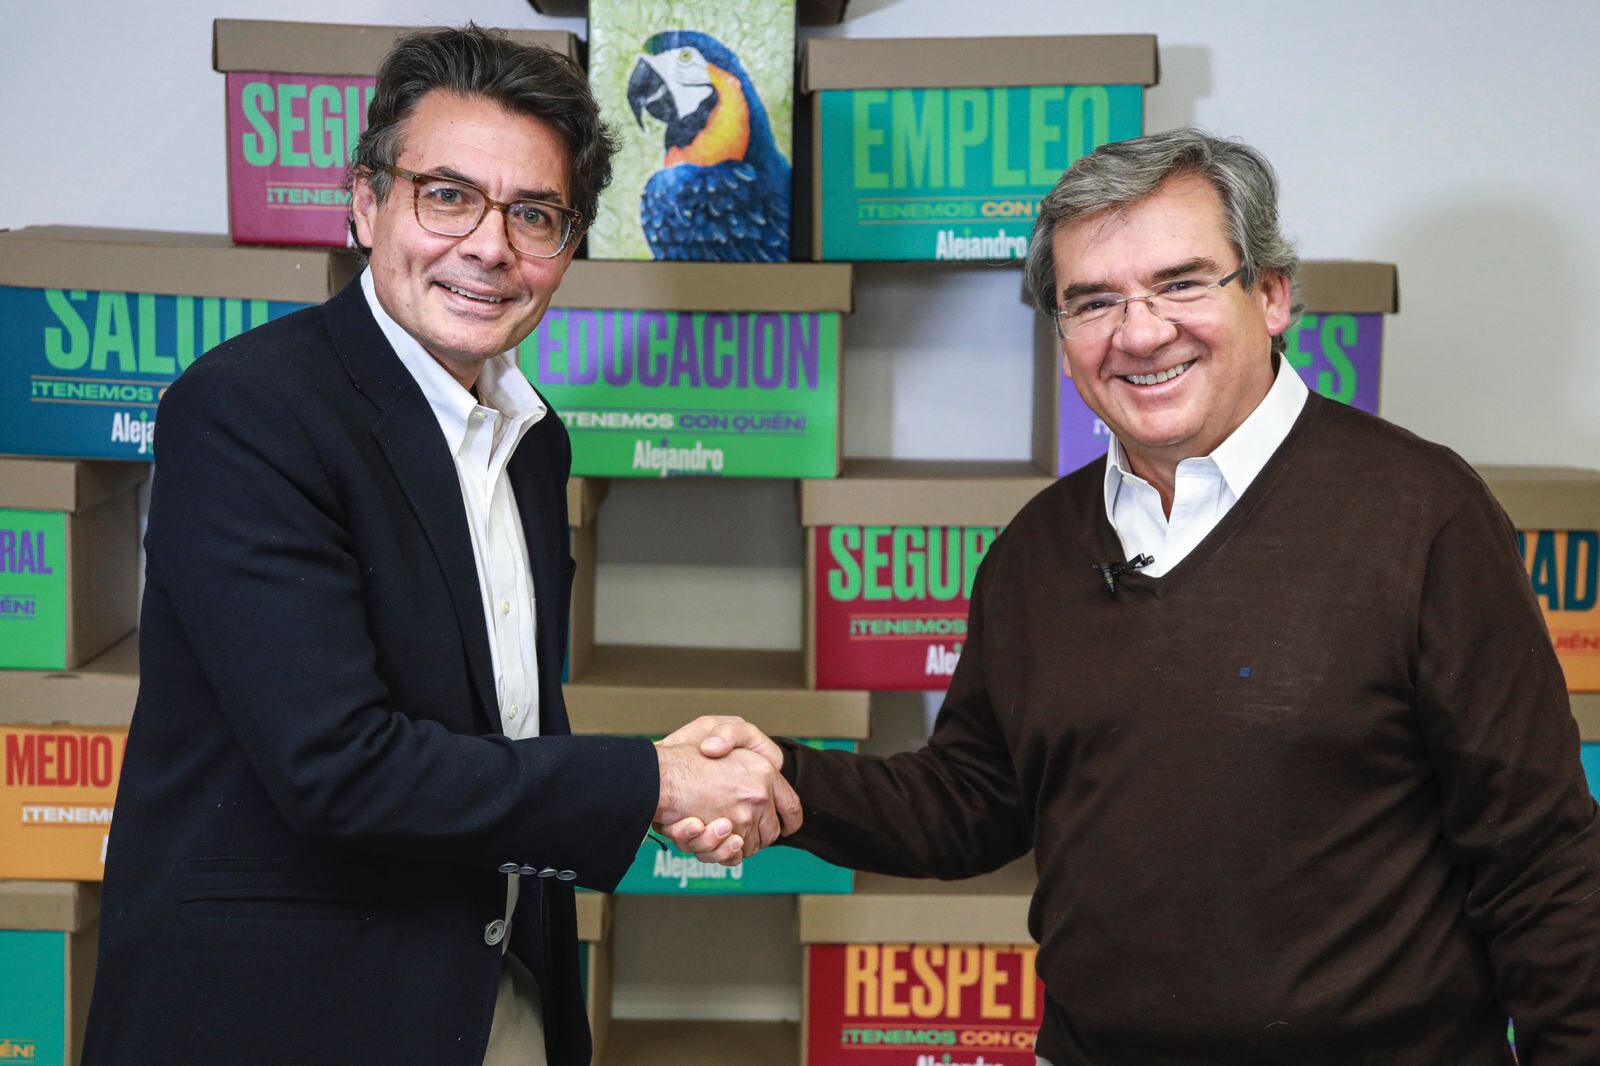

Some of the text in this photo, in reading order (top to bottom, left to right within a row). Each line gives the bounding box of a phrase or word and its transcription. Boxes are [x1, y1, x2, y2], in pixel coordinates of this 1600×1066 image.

[853, 85, 1110, 189] EMPLEO
[981, 201, 1033, 217] CON
[935, 226, 1028, 260] Alejandro
[31, 380, 154, 402] ¡TENEMOS
[679, 413, 729, 431] CON
[632, 437, 725, 478] Alejandro
[828, 526, 1004, 601] SEGUR
[1516, 529, 1599, 612] AD
[5, 733, 114, 789] MEDIO
[22, 805, 113, 824] ¡TENEM
[844, 944, 1038, 1020] RESPET
[960, 1029, 1011, 1047] CON
